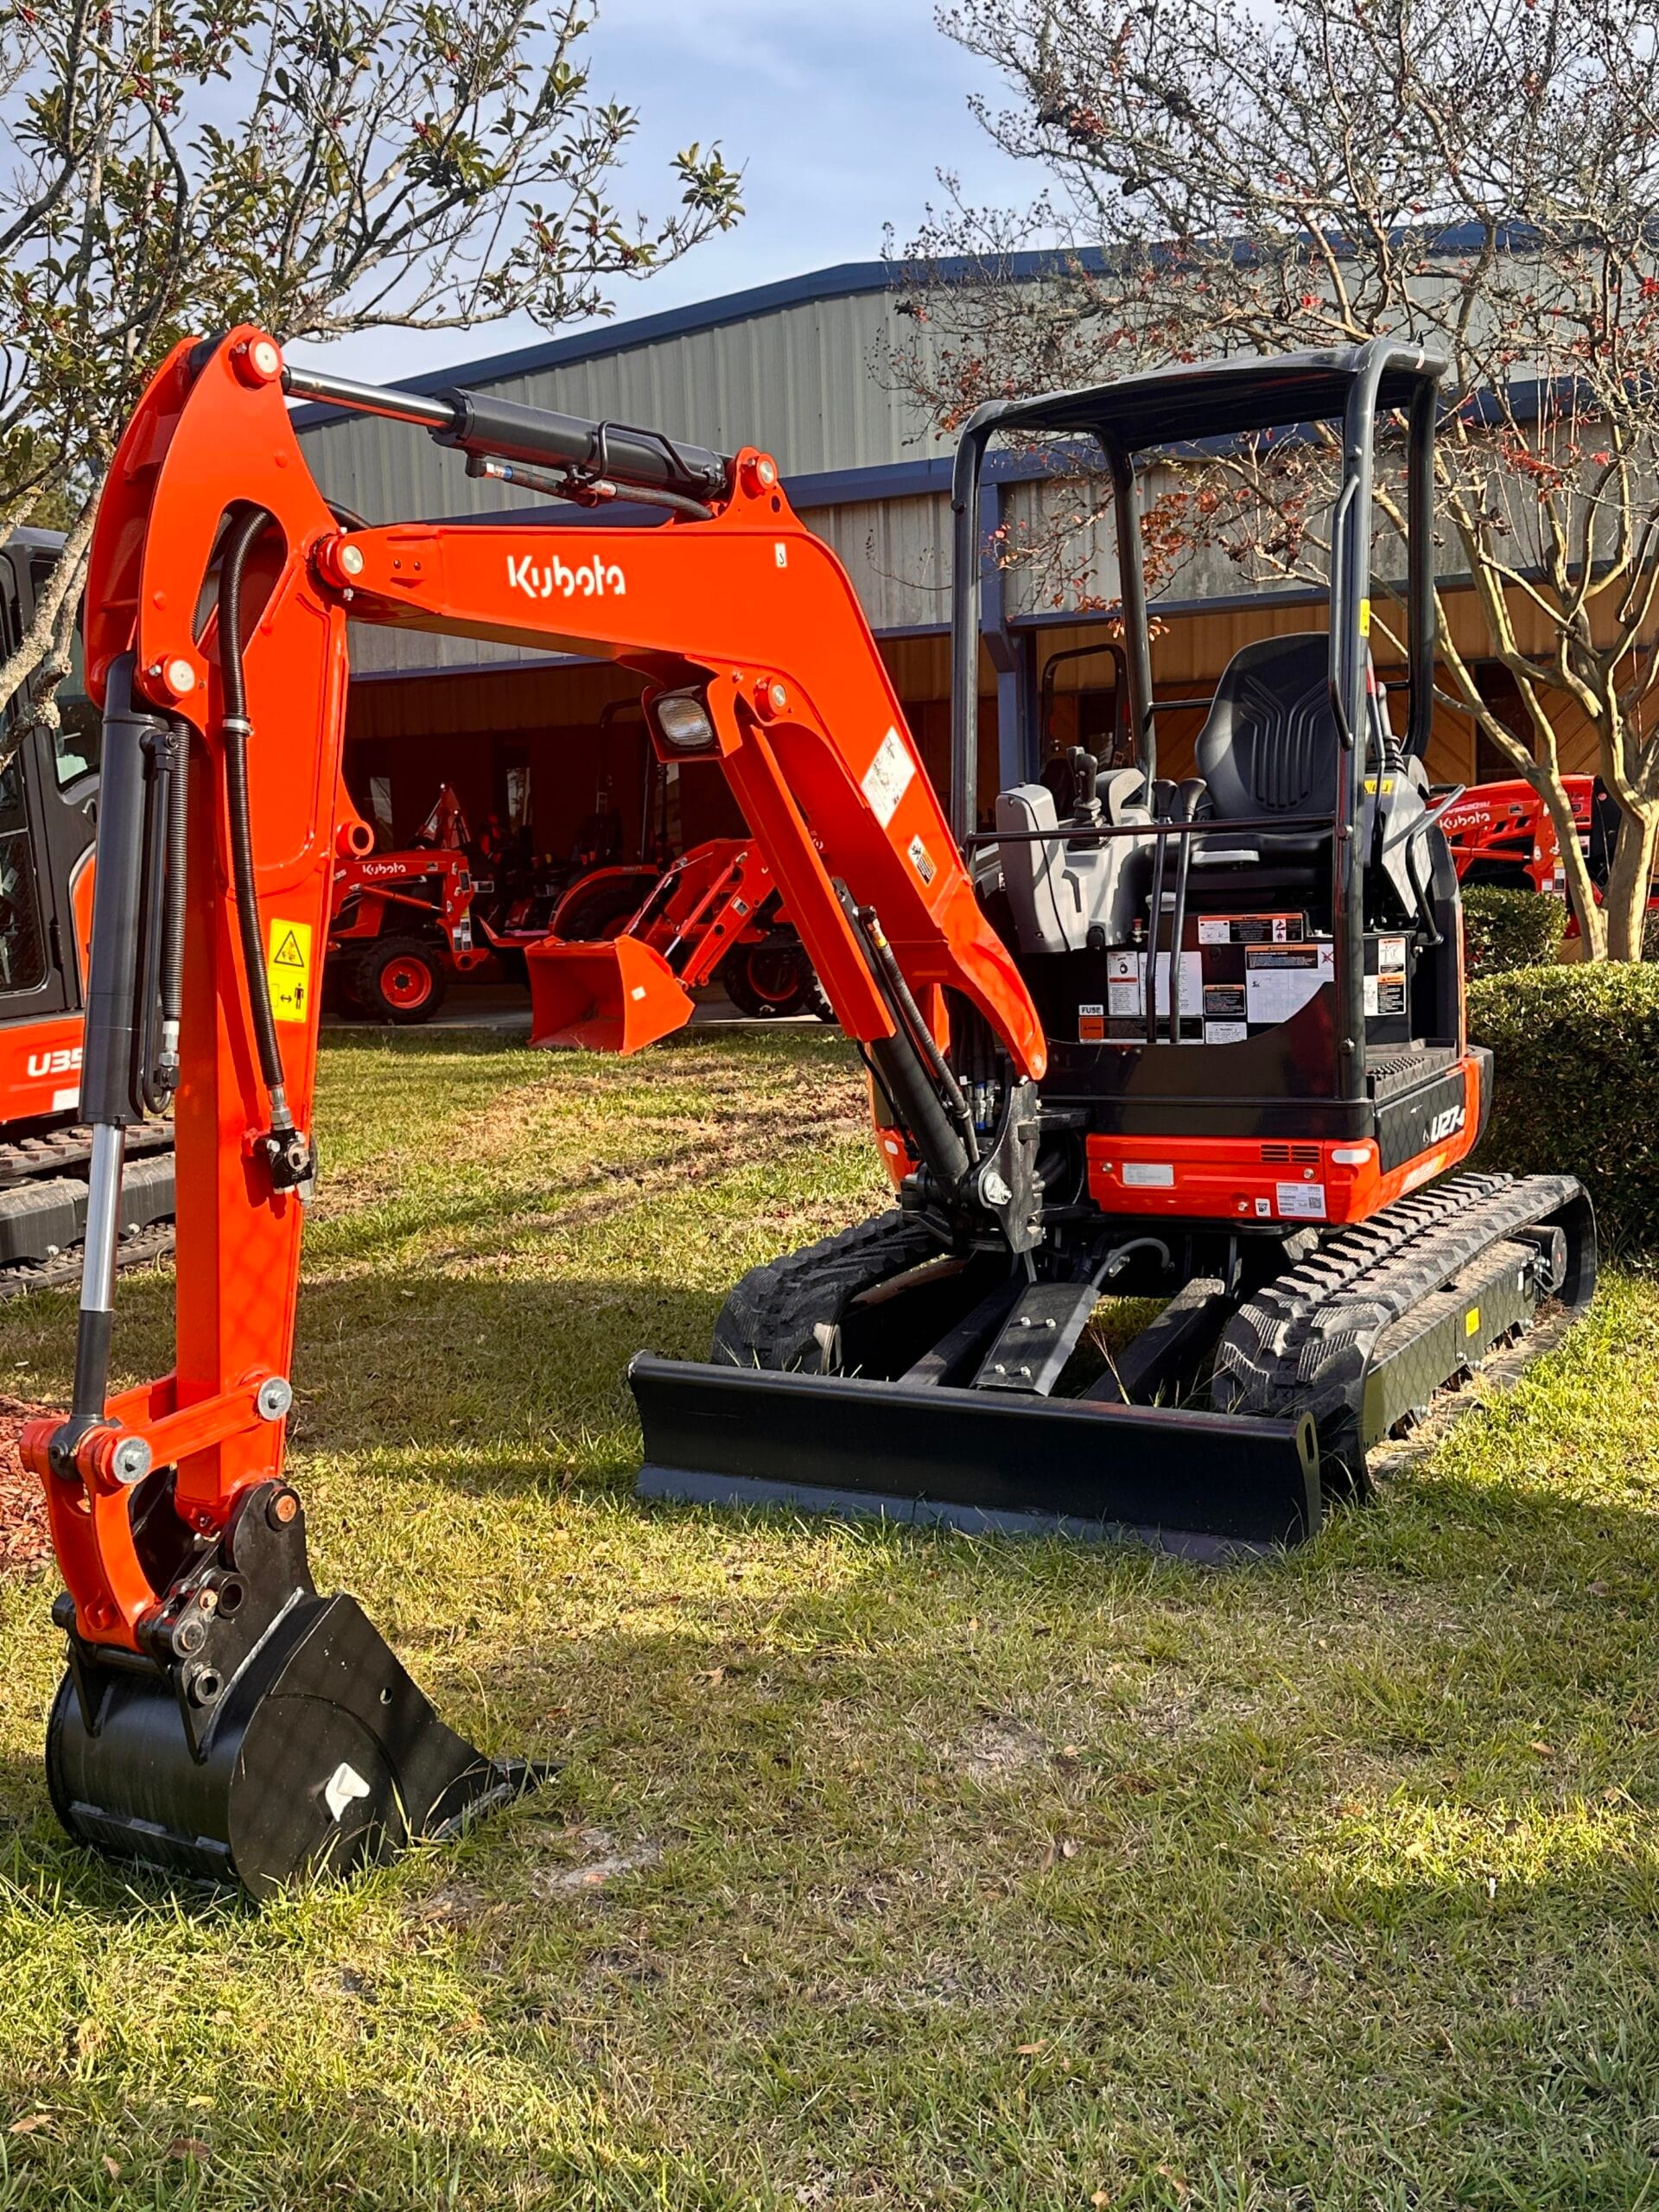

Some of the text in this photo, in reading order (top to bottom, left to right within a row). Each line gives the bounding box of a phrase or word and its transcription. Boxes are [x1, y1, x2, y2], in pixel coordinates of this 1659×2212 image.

[507, 555, 626, 598] Kubota
[1440, 811, 1491, 830] Kubota
[362, 862, 406, 875] Kubota
